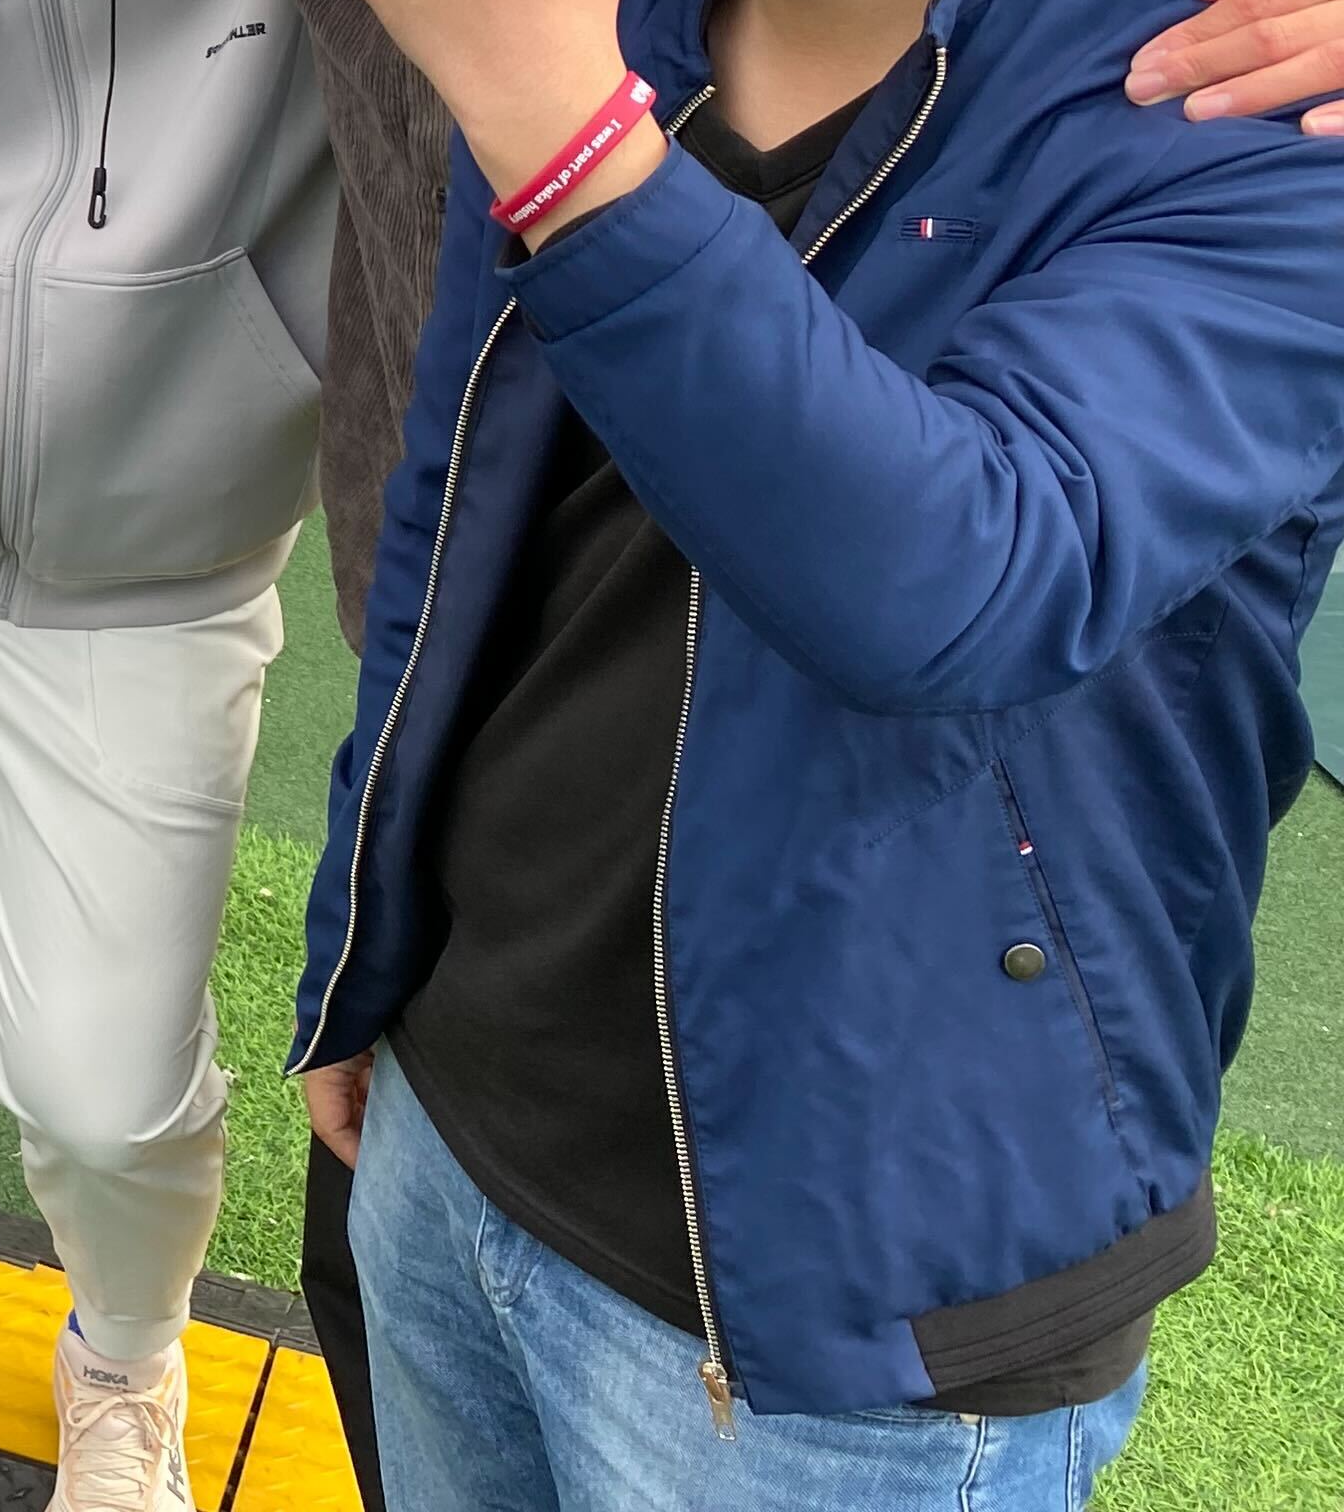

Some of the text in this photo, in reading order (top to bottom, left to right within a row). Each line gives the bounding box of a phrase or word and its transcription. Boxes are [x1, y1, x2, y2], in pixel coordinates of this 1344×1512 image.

[509, 118, 623, 225] I was part of haka history
[83, 1365, 129, 1386] HOKA
